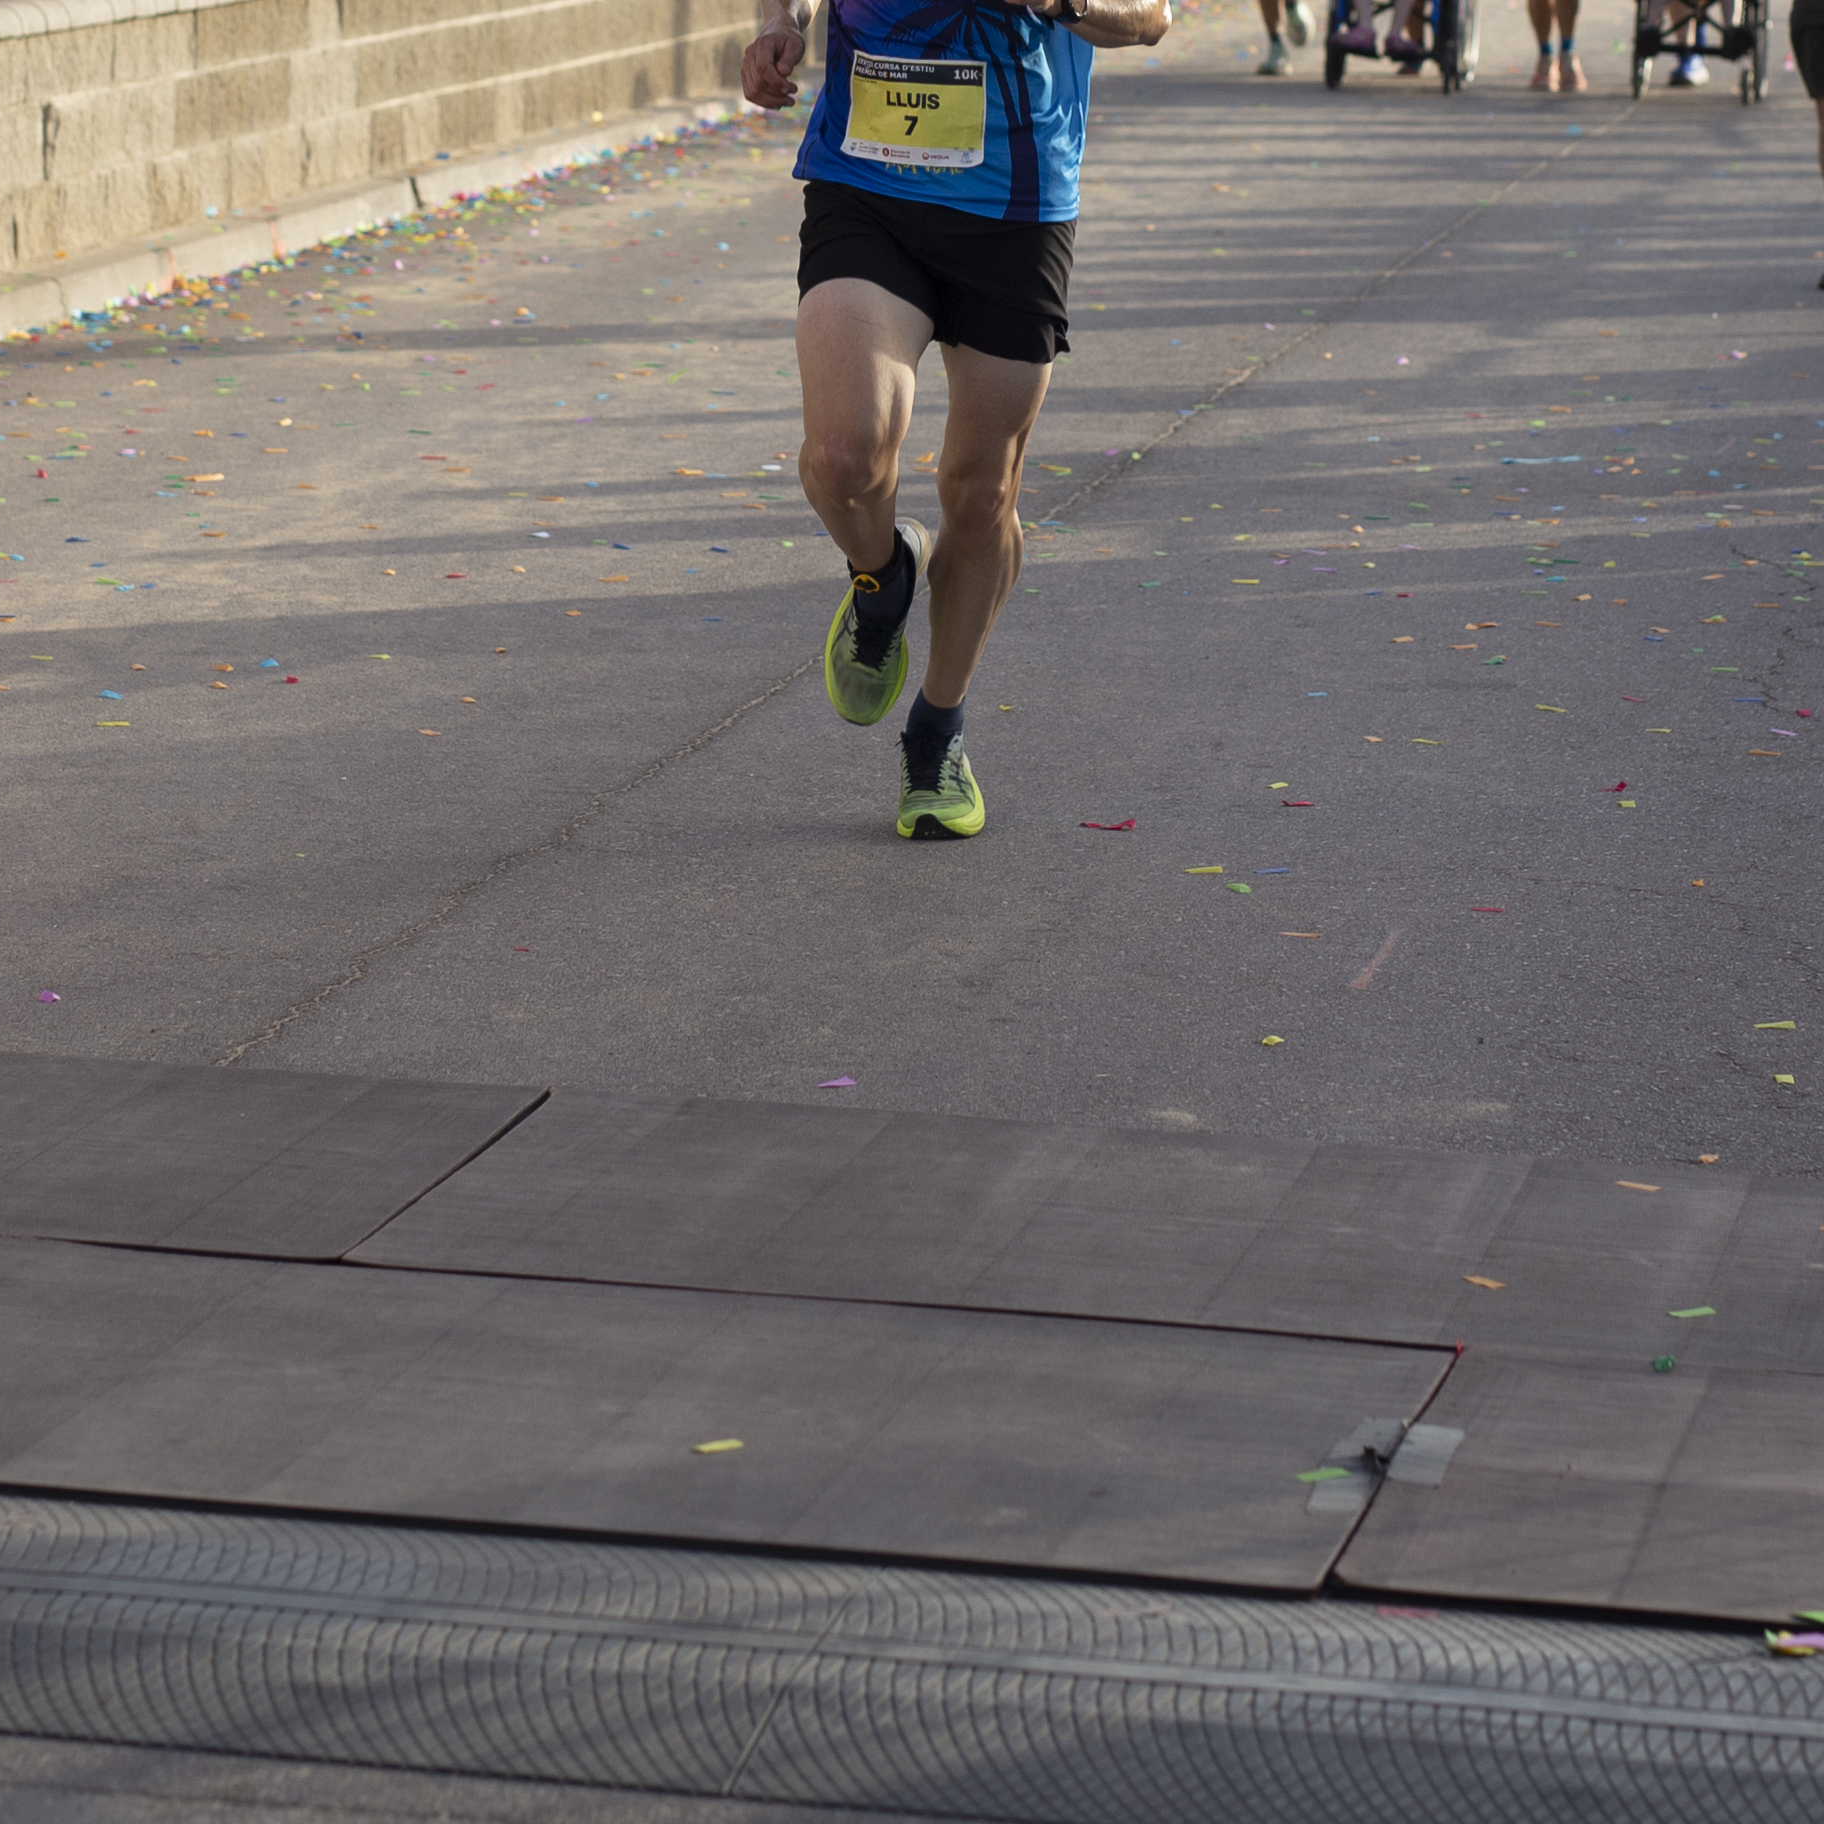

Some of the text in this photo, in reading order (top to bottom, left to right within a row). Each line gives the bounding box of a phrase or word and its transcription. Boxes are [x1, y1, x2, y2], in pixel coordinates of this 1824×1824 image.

[874, 62, 900, 71] CURSA
[902, 65, 935, 73] D'ESTIU
[878, 70, 888, 78] DE
[889, 71, 908, 79] MAR
[886, 90, 940, 110] LLUIS
[904, 114, 919, 136] 7
